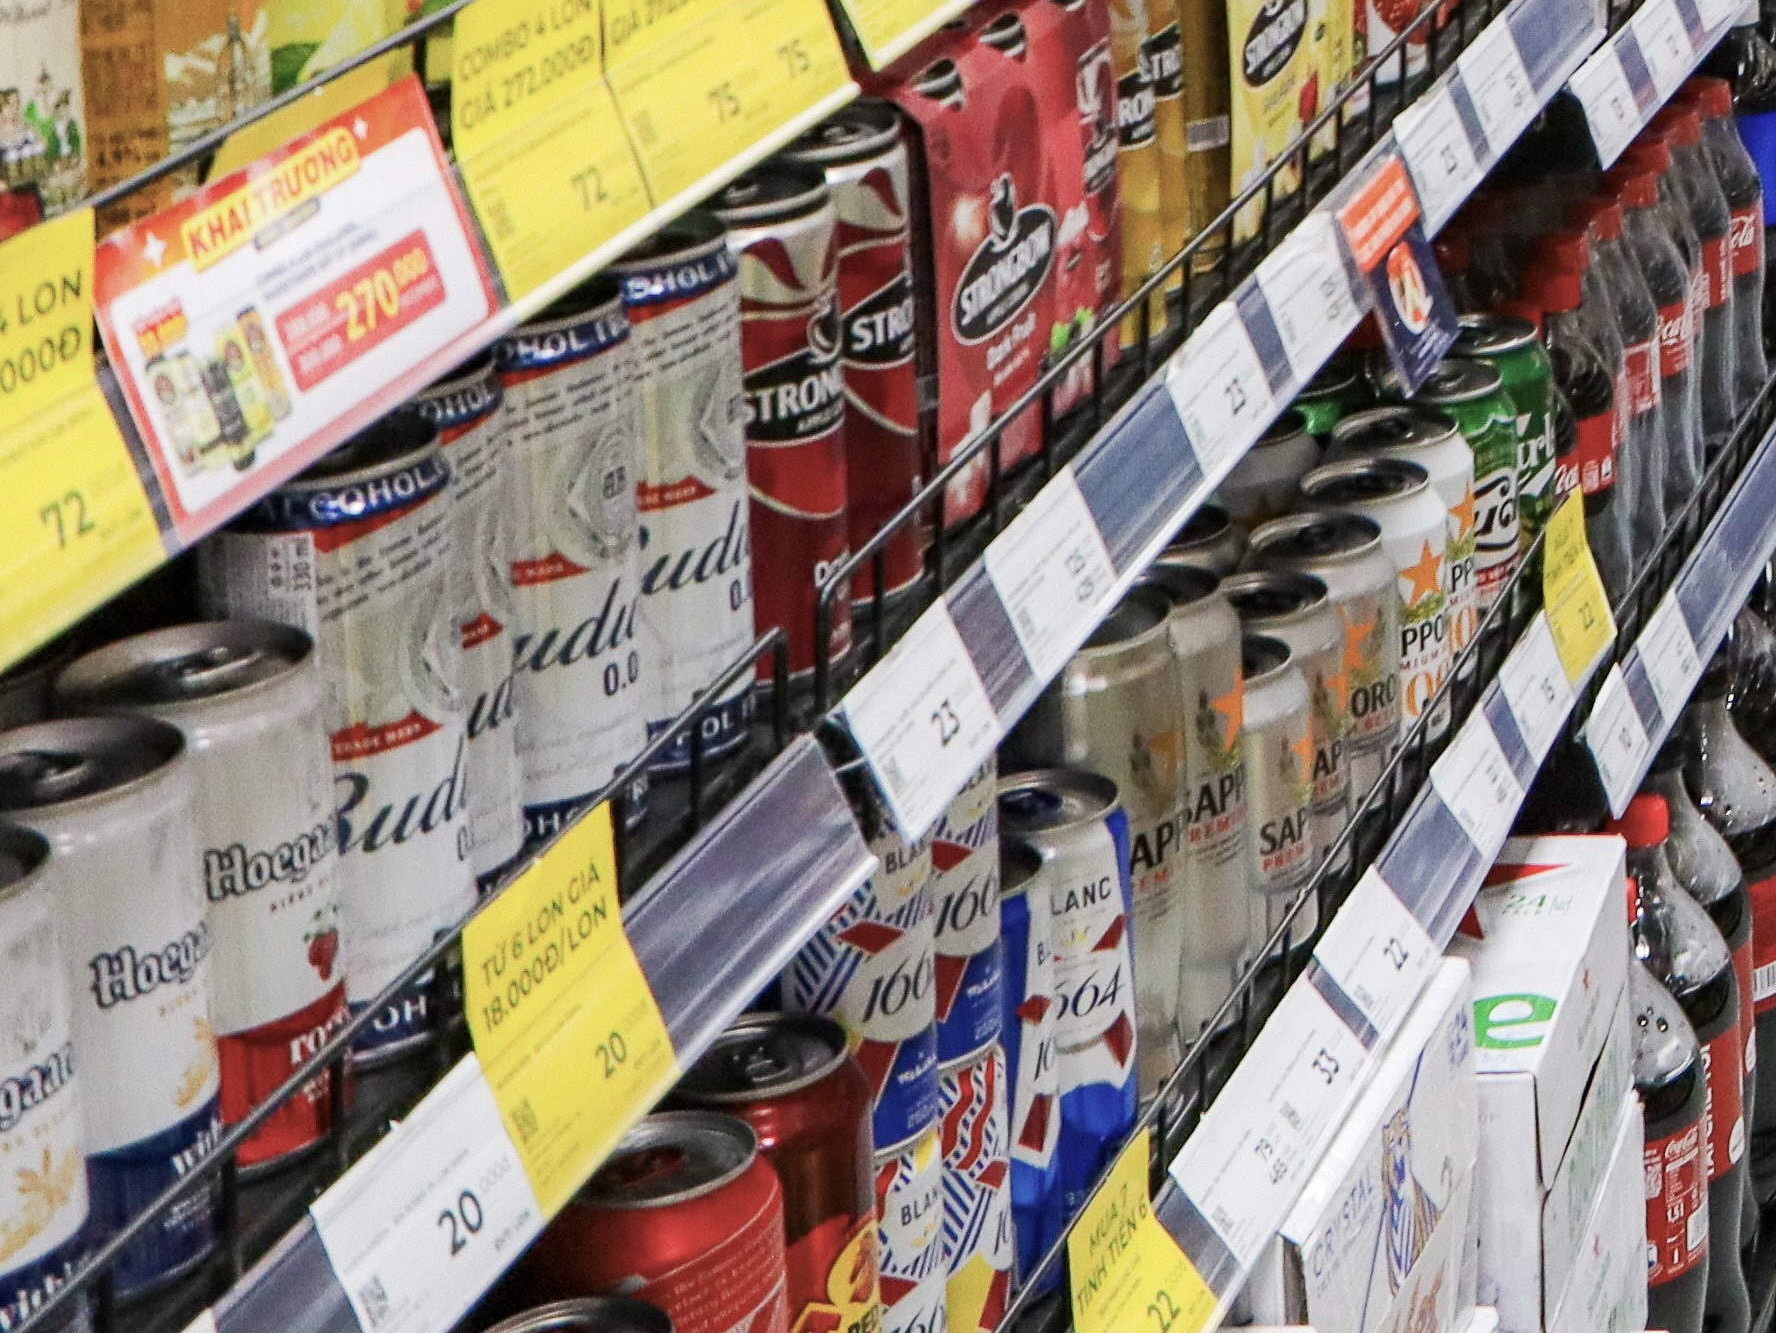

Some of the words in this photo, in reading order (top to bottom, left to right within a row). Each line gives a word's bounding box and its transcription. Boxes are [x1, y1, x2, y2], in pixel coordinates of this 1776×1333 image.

[457, 15, 530, 82] COMBO
[609, 7, 641, 50] GIÁ
[1244, 0, 1308, 78] STRONGBOW
[458, 85, 497, 132] GIÁ
[503, 35, 595, 109] 272.000Đ
[778, 39, 811, 79] 75
[708, 82, 741, 124] 75
[187, 198, 245, 262] KHAI
[249, 127, 355, 219] TRƯƠNG
[570, 165, 610, 212] 72
[18, 271, 81, 324] LON
[956, 233, 1051, 328] STRONGBOW
[337, 281, 400, 344] 270
[1225, 377, 1247, 416] 23
[39, 490, 96, 550] 72
[603, 654, 641, 699] 0.0
[931, 699, 960, 747] 23
[1049, 873, 1115, 919] LANC
[480, 937, 508, 988] TỪ
[511, 935, 524, 960] 6
[527, 894, 566, 946] LON
[568, 856, 601, 906] GIÁ
[483, 894, 608, 1034] 18.000Đ/LON
[1384, 937, 1409, 971] 22
[595, 1031, 626, 1079] 20
[1312, 1049, 1339, 1085] 33
[438, 1190, 483, 1256] 20
